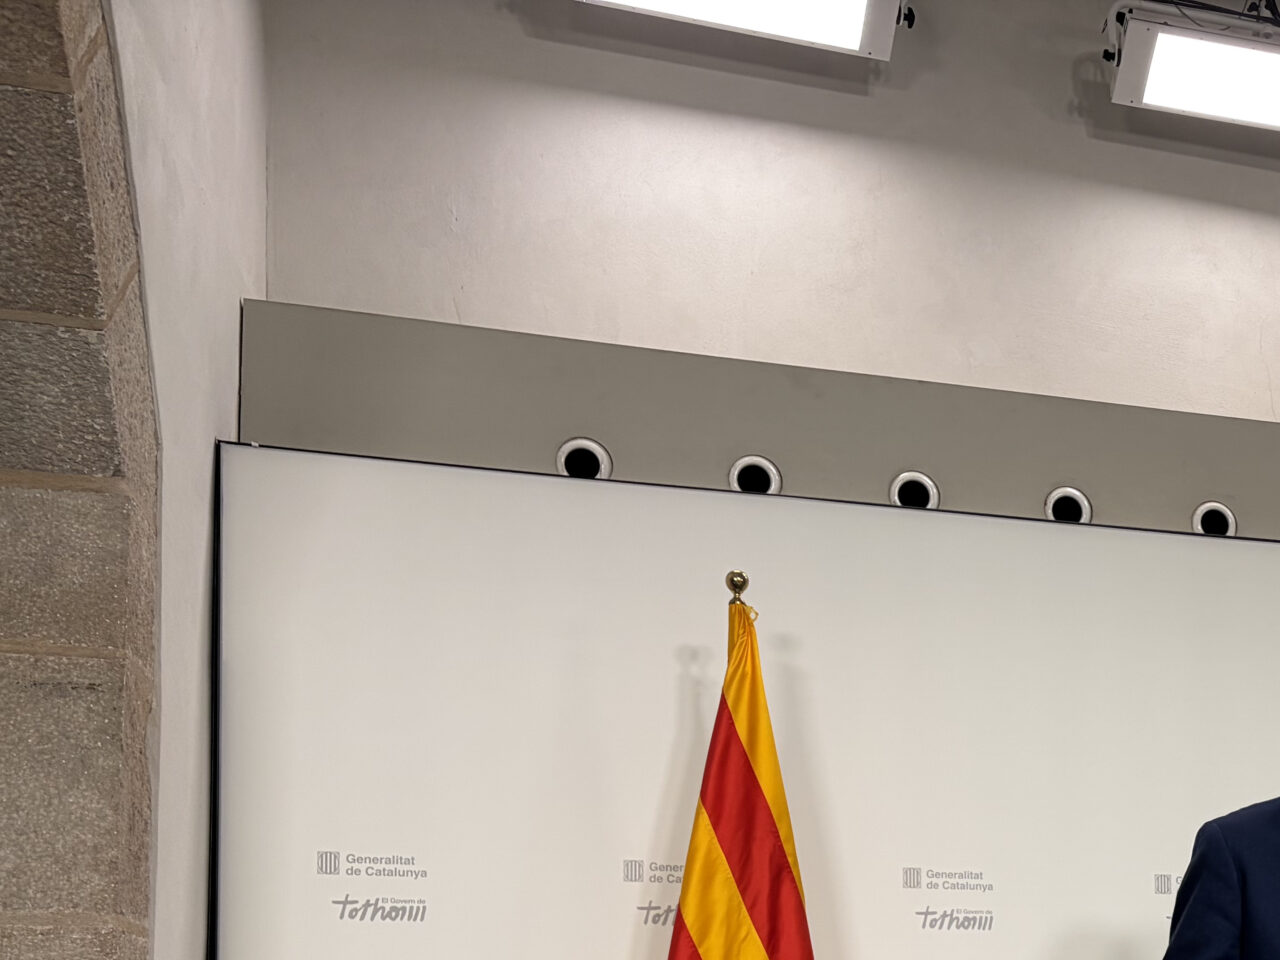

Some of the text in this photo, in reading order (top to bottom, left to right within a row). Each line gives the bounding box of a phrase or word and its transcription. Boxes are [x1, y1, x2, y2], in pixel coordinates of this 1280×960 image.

[346, 853, 415, 866] Generalitat
[345, 866, 428, 880] de Catalunya
[649, 861, 685, 873] Gener
[649, 874, 663, 884] de
[926, 869, 983, 880] Generalitat
[926, 881, 994, 893] de Catalunya
